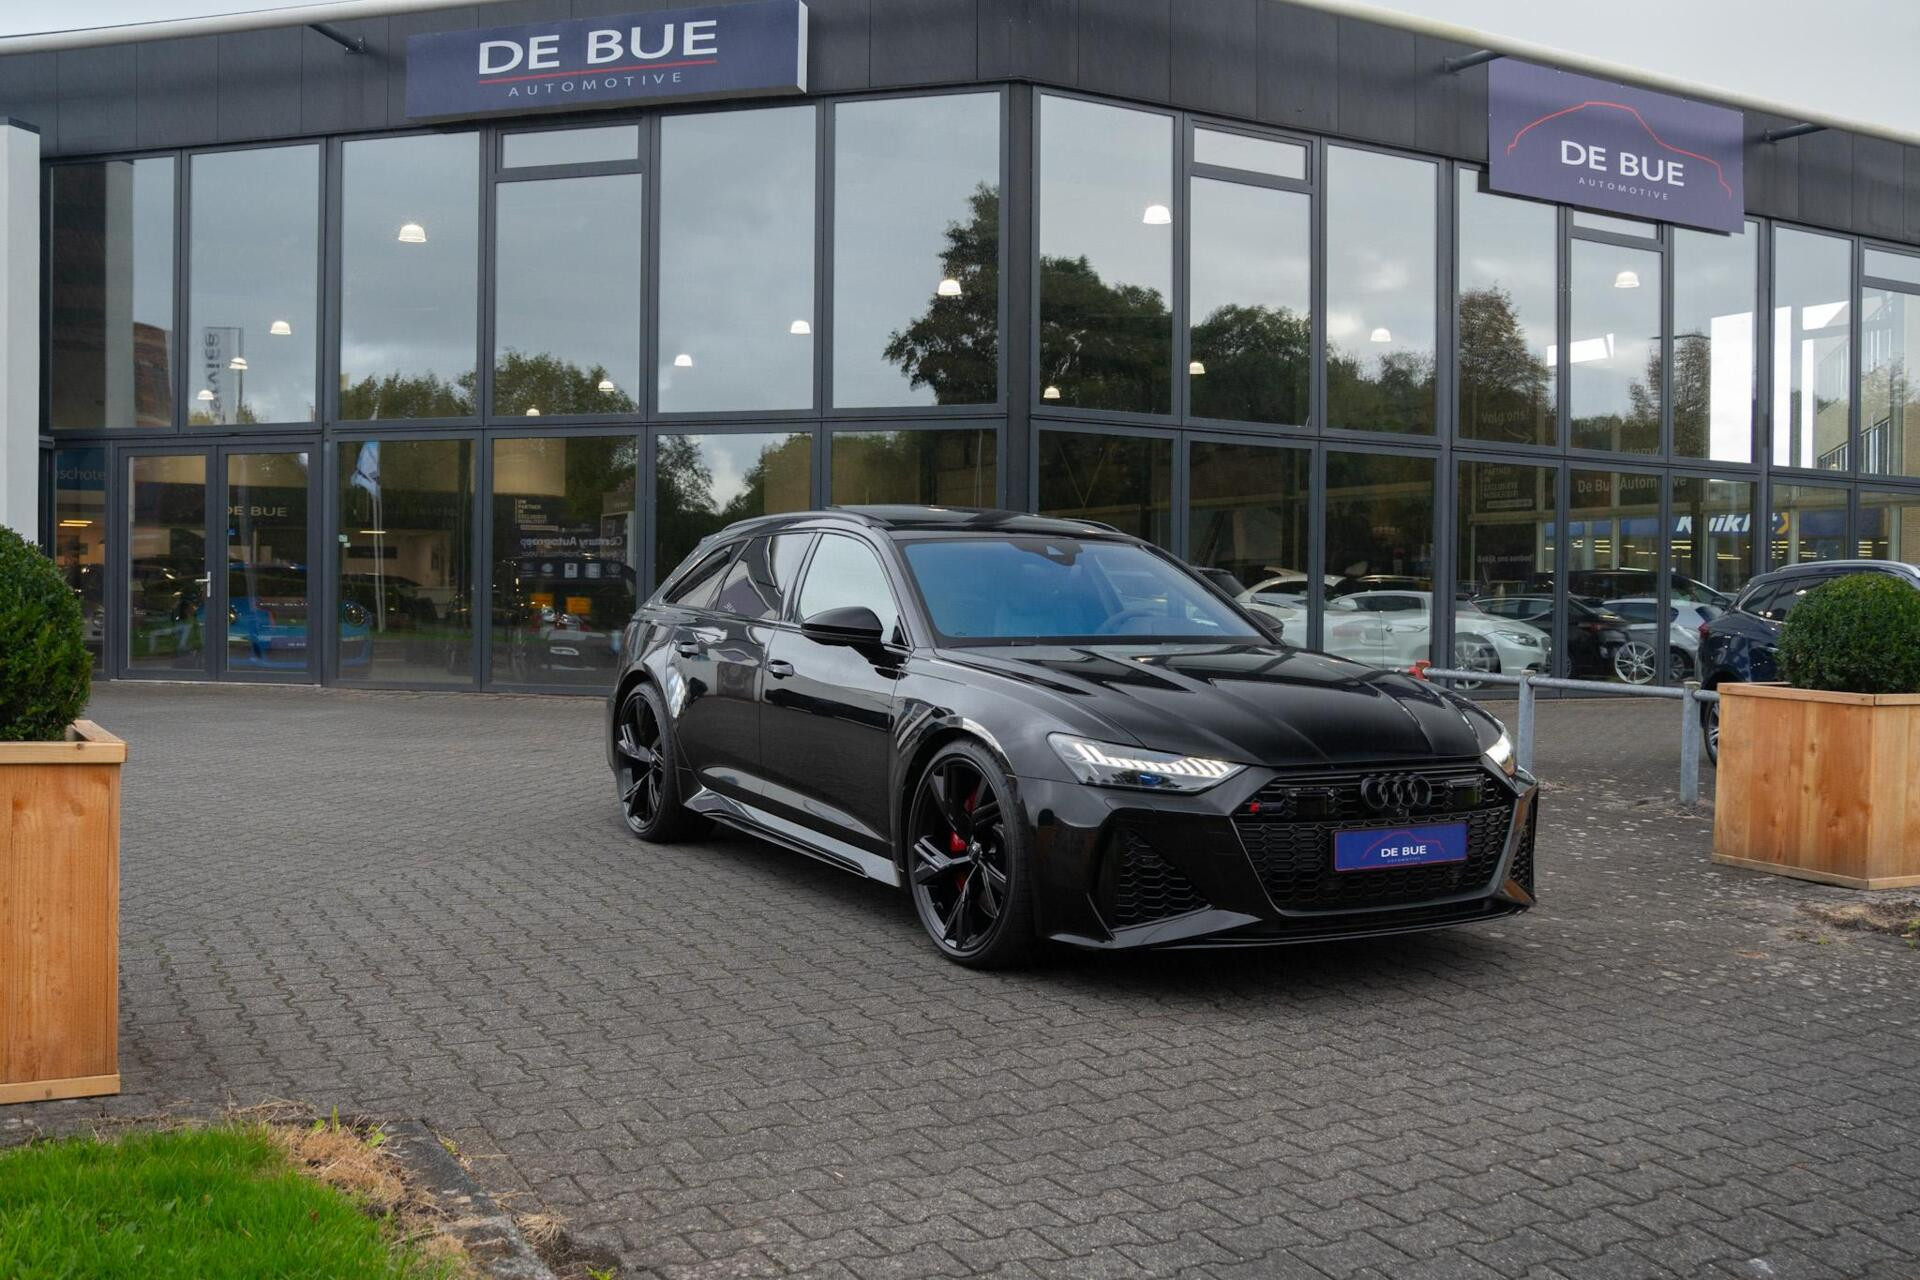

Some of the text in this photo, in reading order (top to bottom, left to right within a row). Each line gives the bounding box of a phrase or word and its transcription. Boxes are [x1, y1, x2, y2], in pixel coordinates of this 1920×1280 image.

[478, 19, 718, 75] DE BUE
[508, 72, 682, 97] AUTOMOTIVE
[1561, 140, 1685, 187] DE BUE
[1578, 176, 1669, 201] AUTOMOTIVE
[250, 505, 288, 517] BUE
[1381, 845, 1427, 858] DE BUE
